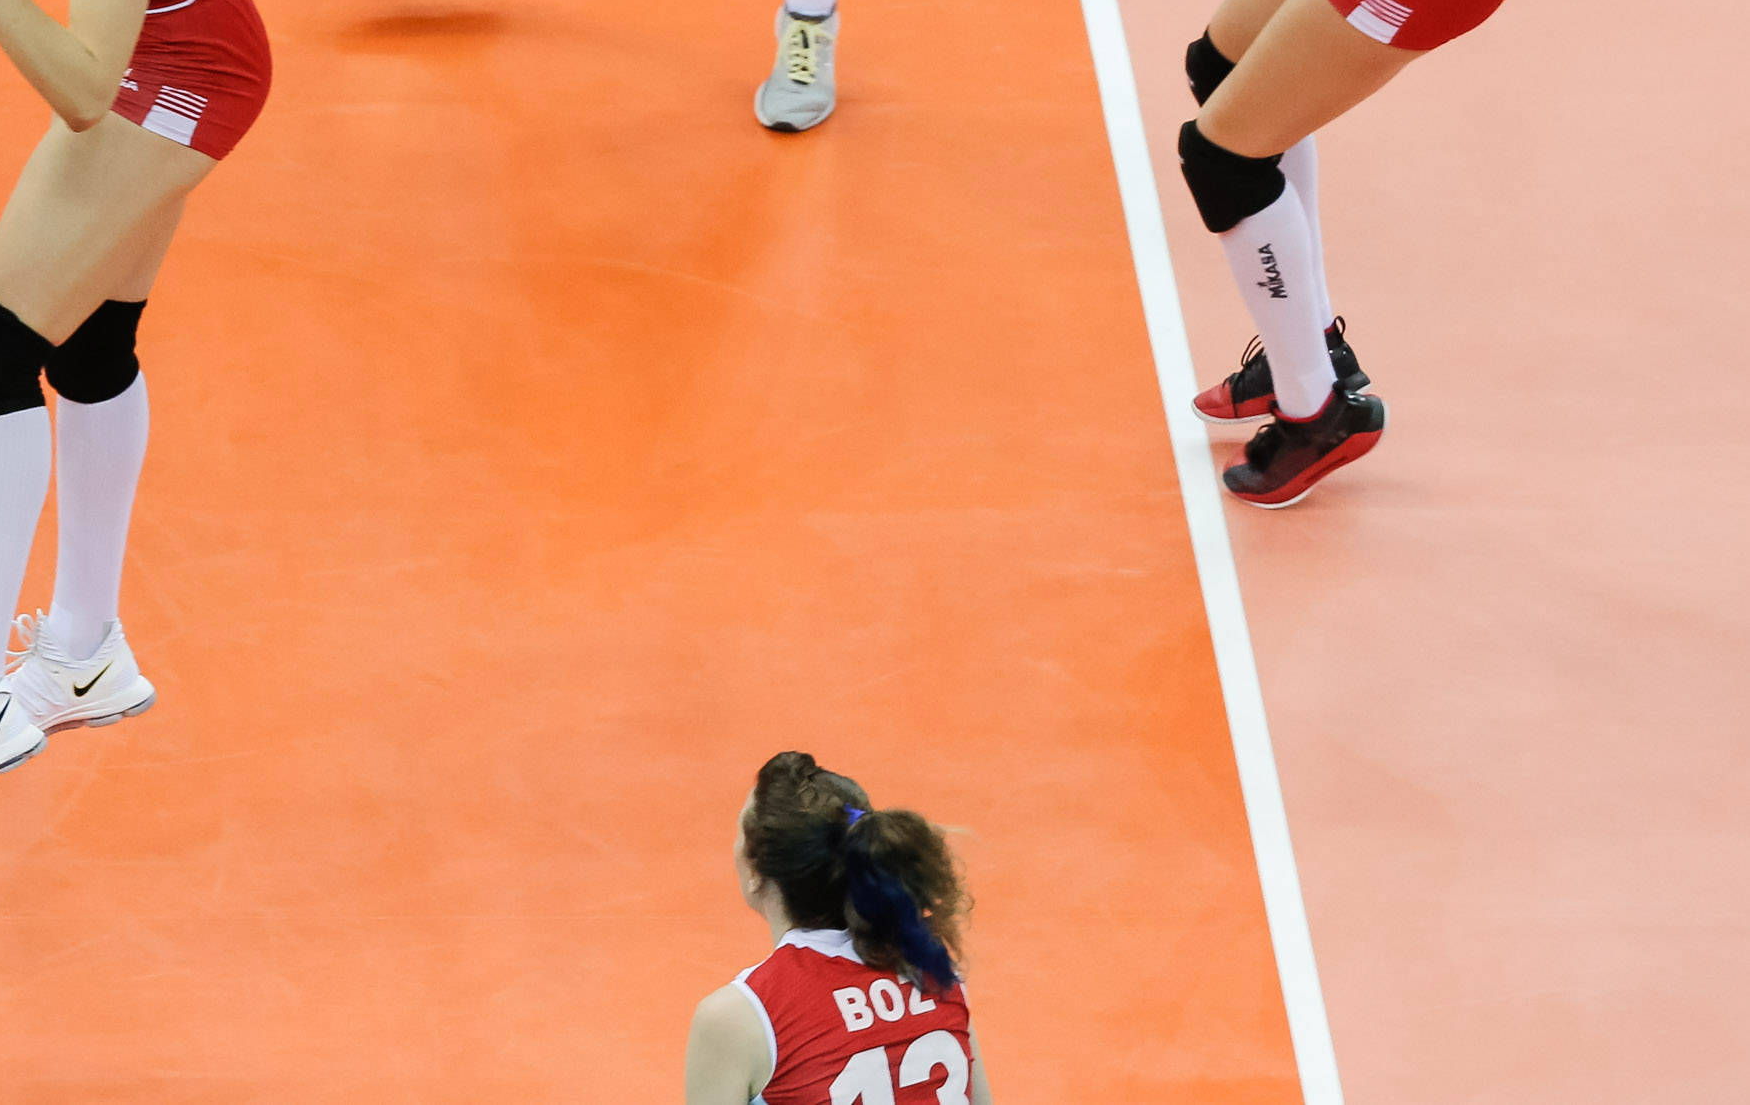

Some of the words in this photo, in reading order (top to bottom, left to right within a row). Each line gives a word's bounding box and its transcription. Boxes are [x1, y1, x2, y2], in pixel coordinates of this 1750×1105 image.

[1257, 243, 1288, 298] MIKASA
[832, 975, 937, 1032] BOZ
[829, 1030, 970, 1105] 13
